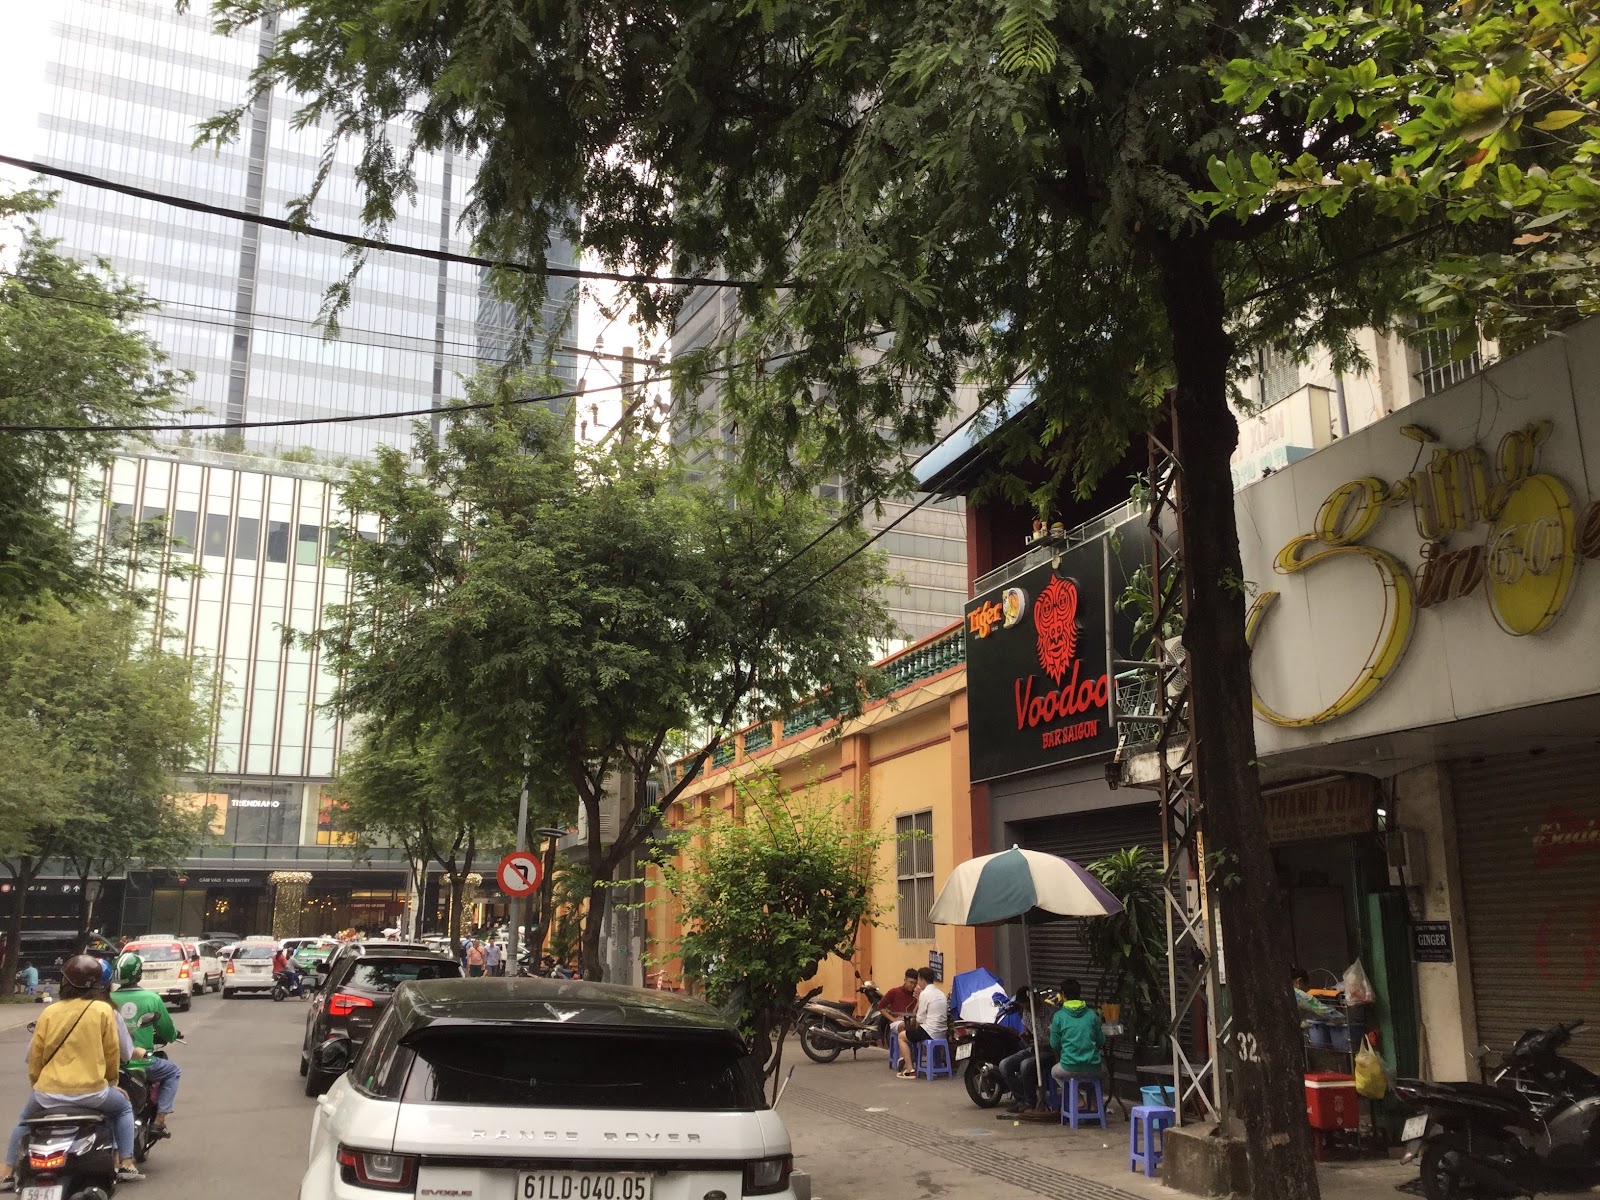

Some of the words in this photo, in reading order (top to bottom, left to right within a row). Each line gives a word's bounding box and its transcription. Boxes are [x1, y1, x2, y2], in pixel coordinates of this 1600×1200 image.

[967, 600, 1003, 639] Tiger
[1014, 659, 1117, 730] Voodoo
[1042, 729, 1062, 749] BAR
[1062, 720, 1098, 744] SAIGON
[1417, 934, 1447, 946] GINGER
[1237, 1032, 1261, 1063] 32
[471, 1129, 578, 1142] RANGE
[603, 1131, 701, 1143] ROVER
[421, 1188, 473, 1197] EVOQUE
